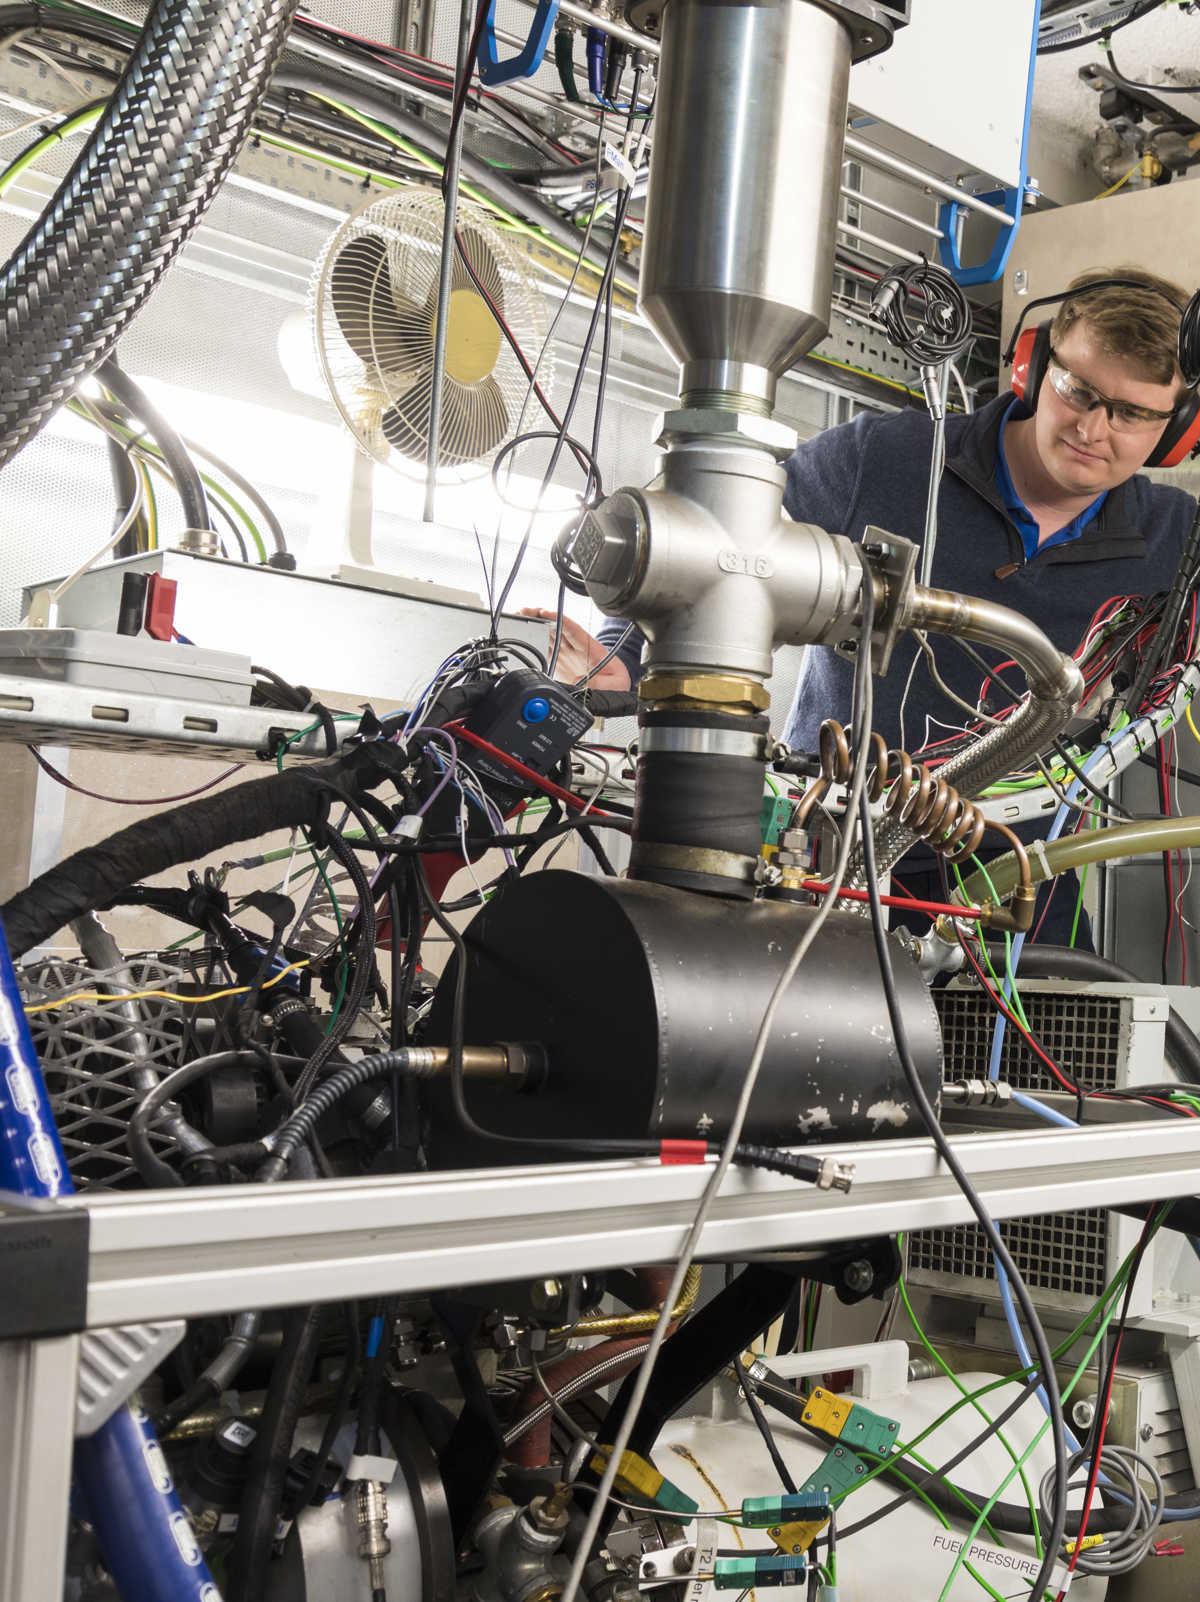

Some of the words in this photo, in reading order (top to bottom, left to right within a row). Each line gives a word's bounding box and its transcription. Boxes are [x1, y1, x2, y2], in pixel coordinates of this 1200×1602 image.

[725, 552, 768, 576] 316
[700, 1546, 714, 1565] T2
[968, 1546, 1039, 1576] PRESSURE
